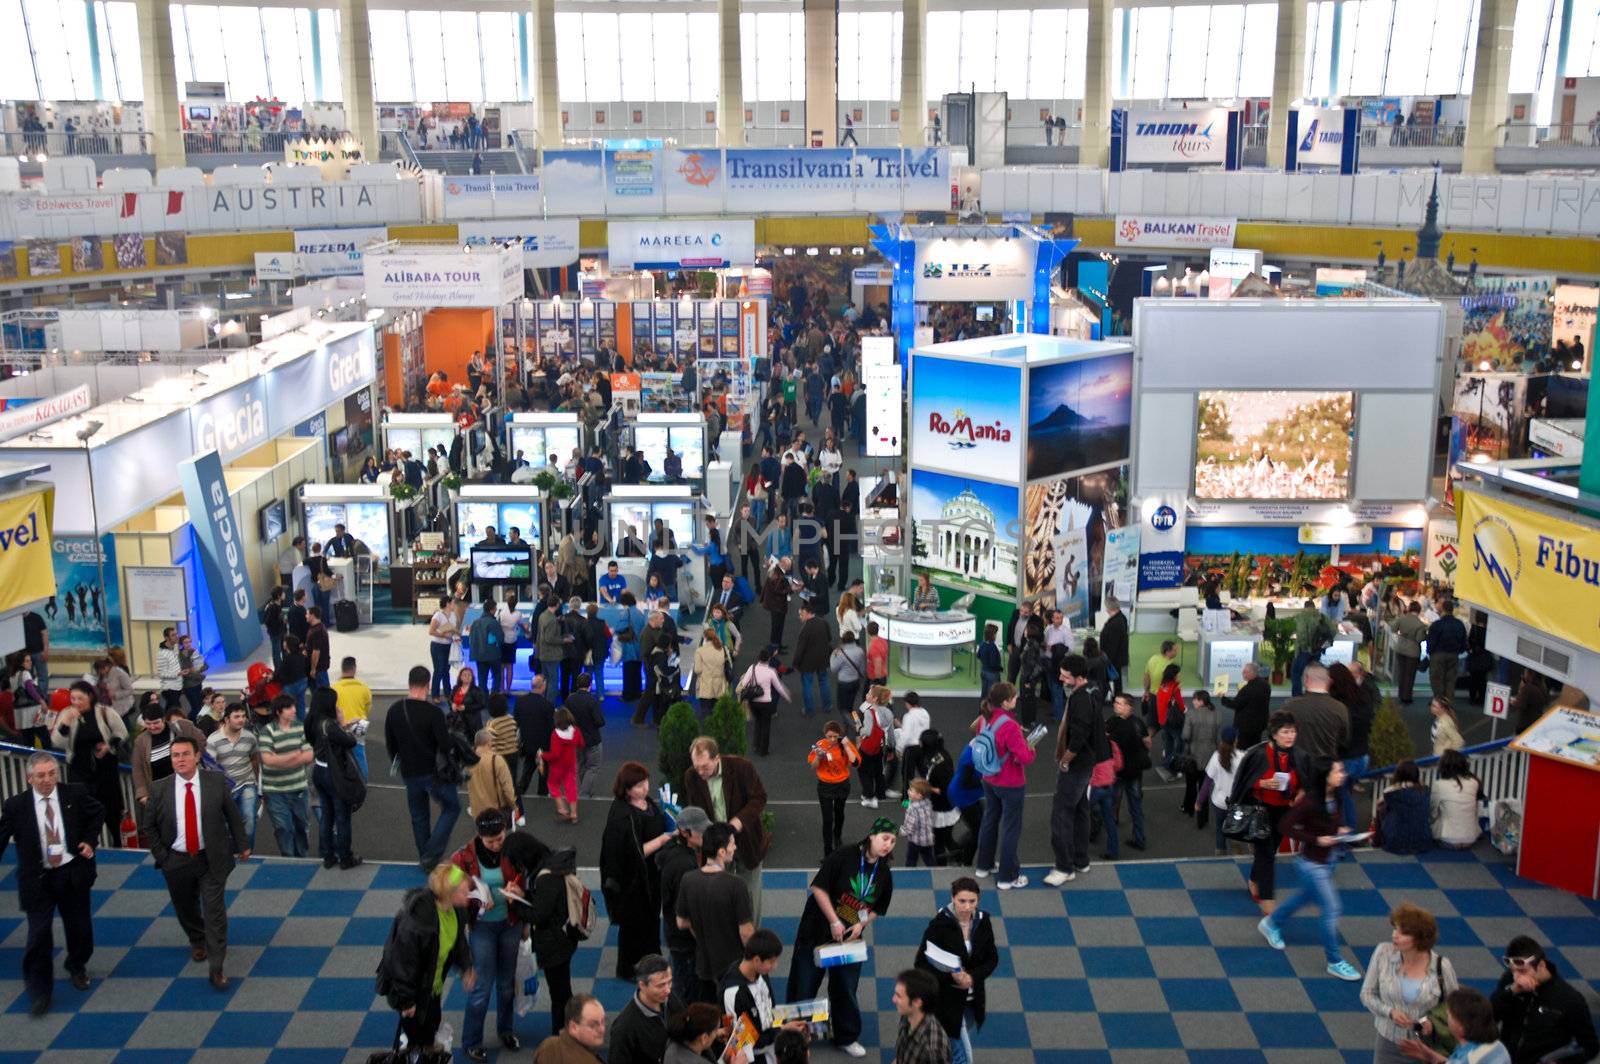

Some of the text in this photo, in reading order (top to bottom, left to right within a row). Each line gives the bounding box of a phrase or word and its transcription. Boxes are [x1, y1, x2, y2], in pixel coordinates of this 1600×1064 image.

[1136, 123, 1197, 136] TAROM
[727, 157, 939, 178] Transilvania Travel
[516, 182, 539, 192] Travel
[213, 185, 372, 212] AUSTRIA
[1144, 223, 1231, 236] BALKAN Travel
[640, 235, 703, 245] MAREEA
[300, 243, 355, 253] REZEDA
[444, 272, 481, 282] TOUR
[197, 393, 265, 452] Grecia
[0, 512, 39, 552] vel
[53, 540, 104, 553] Grecia
[211, 479, 250, 620] Grecia
[1535, 535, 1600, 587] Fibu
[1492, 696, 1504, 714] D
